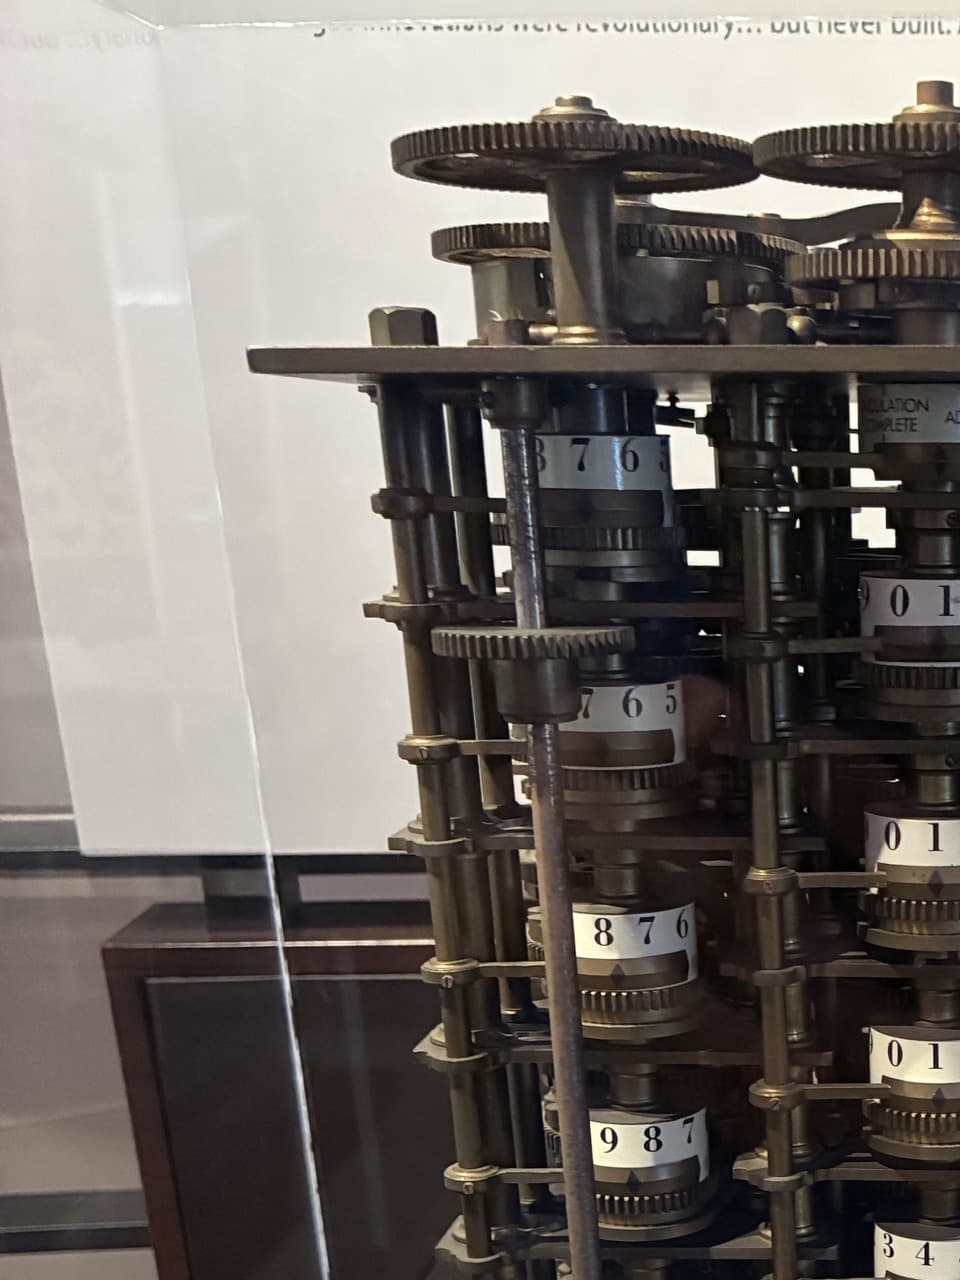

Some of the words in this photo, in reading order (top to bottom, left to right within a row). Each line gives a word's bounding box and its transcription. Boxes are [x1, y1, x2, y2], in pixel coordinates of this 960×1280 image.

[570, 436, 591, 472] 7
[621, 437, 640, 473] 6
[889, 583, 910, 617] 0
[937, 584, 955, 617] 1
[622, 687, 643, 719] 6
[665, 683, 678, 715] 5
[884, 820, 902, 851] 0
[927, 822, 944, 852] 1
[593, 917, 614, 947] 8
[638, 915, 656, 945] 7
[676, 909, 689, 939] 6
[887, 1039, 904, 1068] 0
[927, 1042, 944, 1070] 1
[600, 1126, 619, 1154] 9
[643, 1125, 663, 1153] 8
[682, 1116, 695, 1145] 7
[883, 1232, 895, 1258] 3
[914, 1241, 935, 1267] 4
